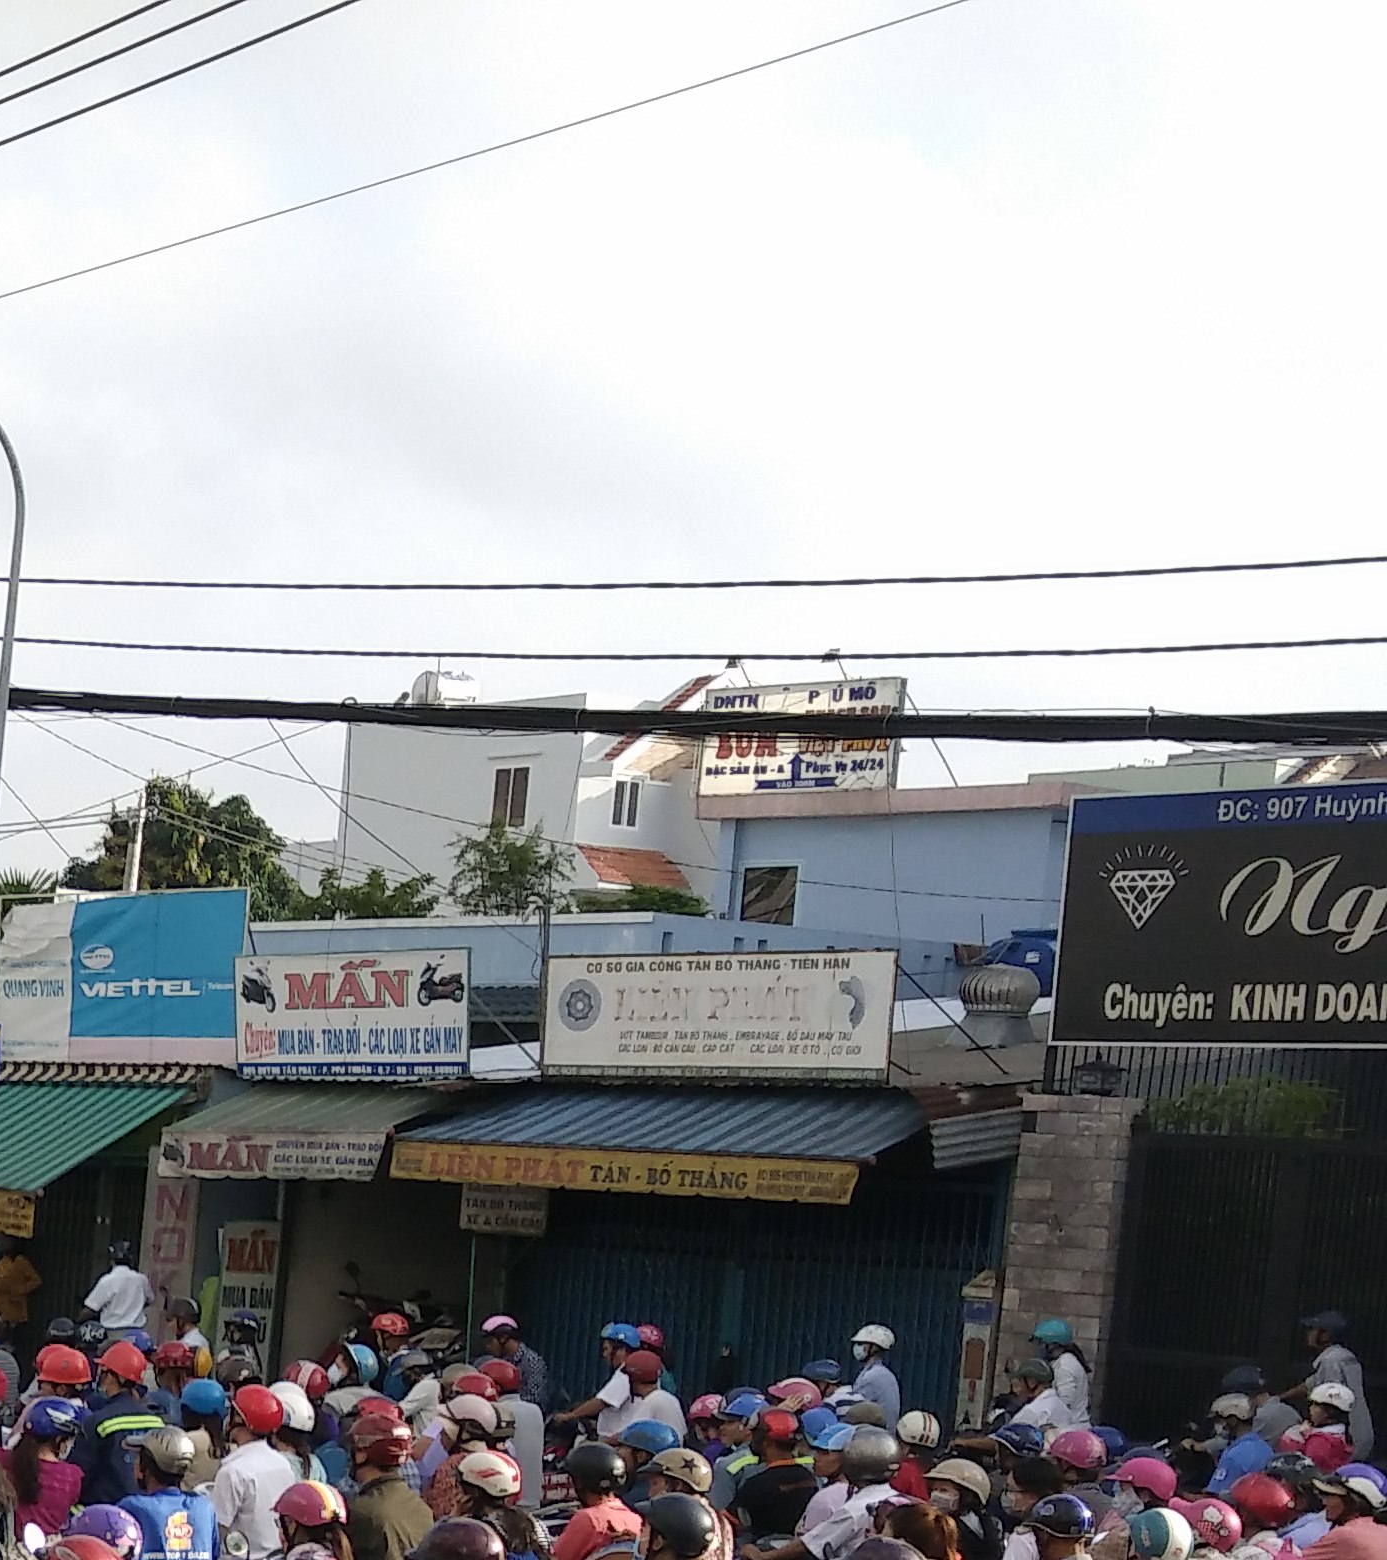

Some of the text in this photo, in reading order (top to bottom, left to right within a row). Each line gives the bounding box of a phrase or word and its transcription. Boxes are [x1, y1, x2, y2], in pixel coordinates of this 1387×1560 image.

[714, 694, 759, 709] DNTN
[805, 757, 885, 777] Phục Vụ 24/24
[1218, 798, 1259, 822] ĐC:
[1266, 796, 1308, 819] 907
[626, 960, 645, 972] GIA
[3, 978, 65, 998] QUANG VINH
[80, 977, 202, 998] VIETTEL
[284, 959, 413, 1010] MẪN
[1103, 982, 1215, 1029] Chuyên:
[1230, 982, 1307, 1023] KINH
[278, 1029, 295, 1055] MUA
[298, 1022, 315, 1055] BÁN
[322, 1028, 344, 1055] TRAO
[346, 1014, 361, 1055] ĐỔI
[368, 1020, 385, 1054] CÁC
[387, 1028, 407, 1058] LOẠI
[409, 1028, 421, 1054] XE
[444, 1019, 464, 1054] MÁY
[187, 1134, 273, 1173] MẪN
[428, 1147, 498, 1177] LIÊN
[505, 1150, 585, 1183] PHÁT
[590, 1161, 632, 1183] TÁN
[646, 1160, 674, 1186] BỐ
[678, 1161, 748, 1191] THẮNG
[221, 1282, 273, 1309] MUA BÁN
